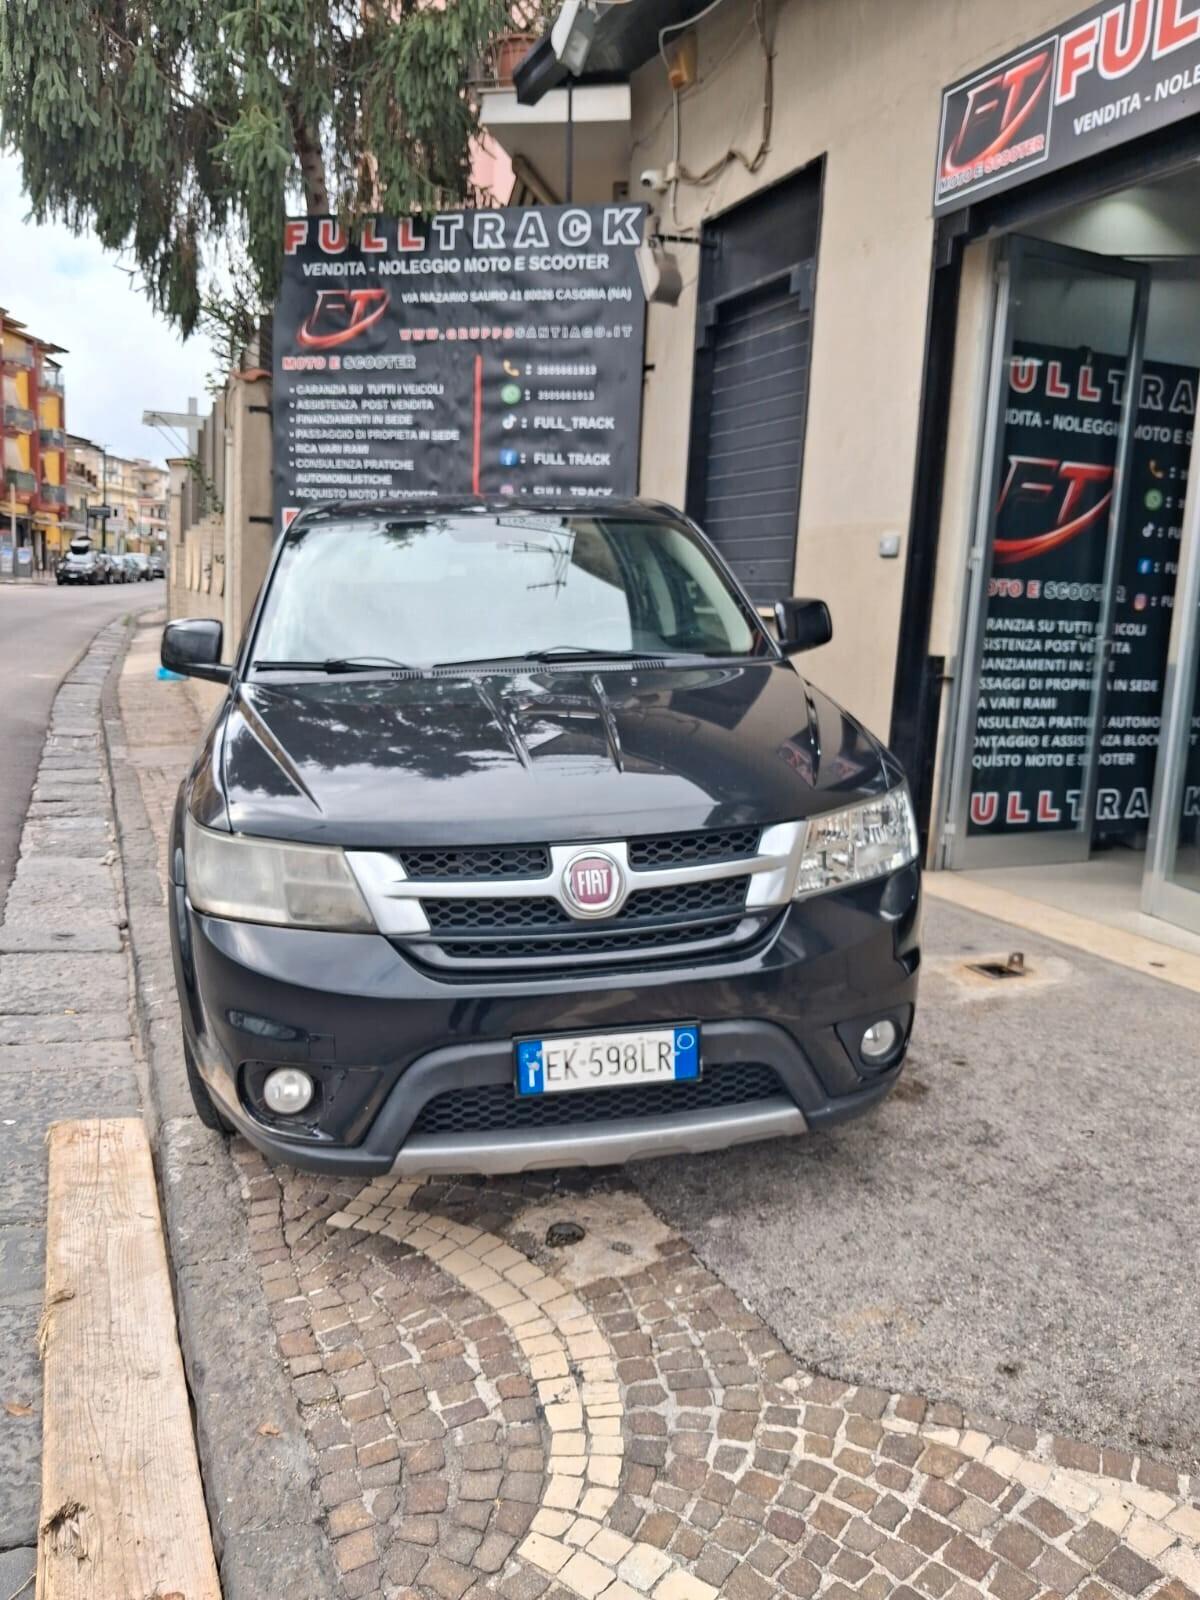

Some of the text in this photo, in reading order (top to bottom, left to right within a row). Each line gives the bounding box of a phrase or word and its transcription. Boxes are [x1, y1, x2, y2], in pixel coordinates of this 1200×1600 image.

[1073, 92, 1141, 136] VENDITA
[303, 261, 366, 276] VENDITA
[378, 258, 460, 275] NOLEGGIO
[464, 257, 510, 273] MOTO
[514, 257, 525, 271] E
[529, 254, 609, 271] SCOOTER
[556, 288, 606, 300] CASORIA
[282, 354, 416, 370] MOTO E SCOOTER
[403, 384, 444, 395] VEICOLI
[296, 400, 435, 411] ASSISTENZA POST VENDITA
[296, 414, 371, 425] FINANZIAMENTI
[1053, 415, 1124, 438] NOLEGGI
[296, 429, 354, 440] PASSAGGIO
[296, 459, 362, 470] CONSULENZA
[533, 452, 565, 465] FULL
[567, 453, 611, 465] TRACK
[296, 473, 392, 485] AUTOMOBILISTICHE
[1026, 579, 1041, 599] E
[1037, 621, 1055, 634] SU
[1056, 622, 1092, 635] TUTTI
[1044, 639, 1077, 652] POST
[1069, 660, 1083, 672] IN
[1029, 678, 1043, 690] DI
[1113, 679, 1128, 692] IN
[1129, 679, 1159, 692] SEDE
[989, 697, 1021, 710] VARI
[1023, 697, 1058, 710] RAMI
[1024, 754, 1064, 767] MOTO
[1065, 755, 1075, 767] E
[576, 867, 610, 897] FIAT
